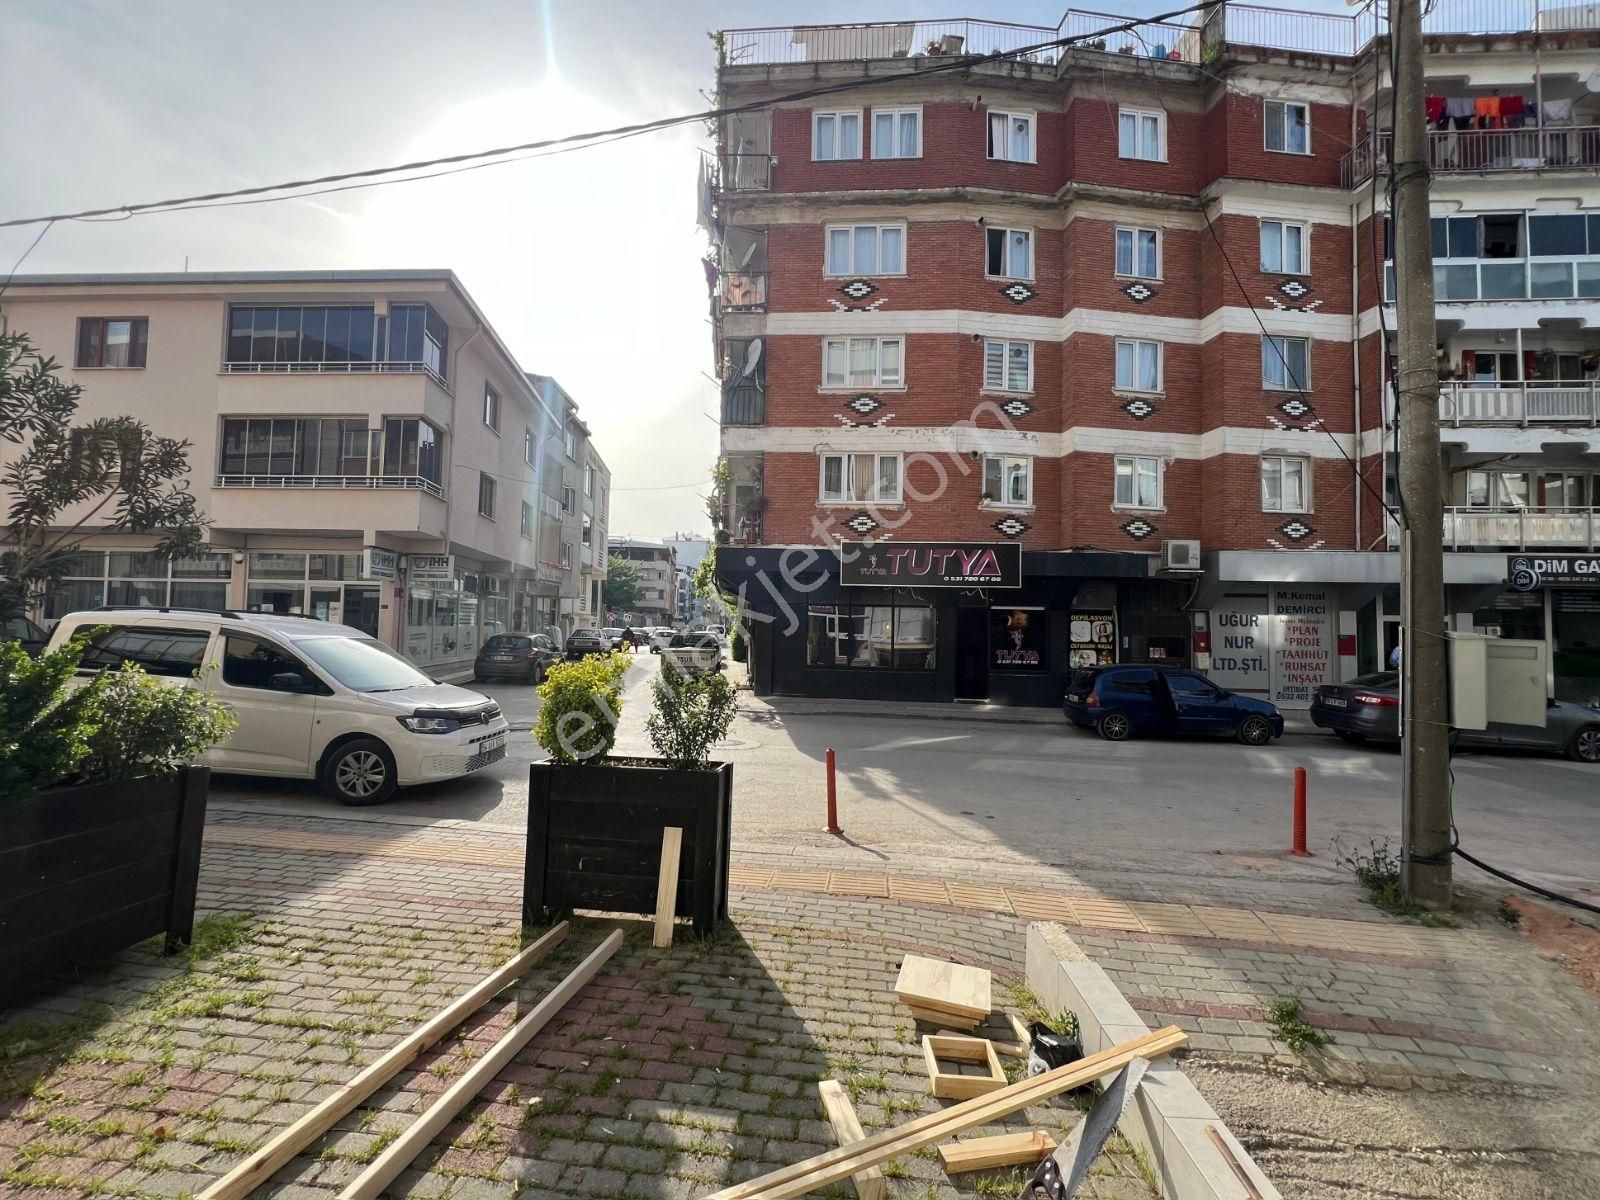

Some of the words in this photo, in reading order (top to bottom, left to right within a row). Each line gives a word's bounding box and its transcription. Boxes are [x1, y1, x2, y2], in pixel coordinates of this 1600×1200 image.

[886, 549, 1002, 575] TUTYA
[1574, 560, 1600, 573] GA
[1219, 611, 1259, 627] UĞUR
[1224, 636, 1254, 649] NUR
[1285, 662, 1327, 671] RUHSAT
